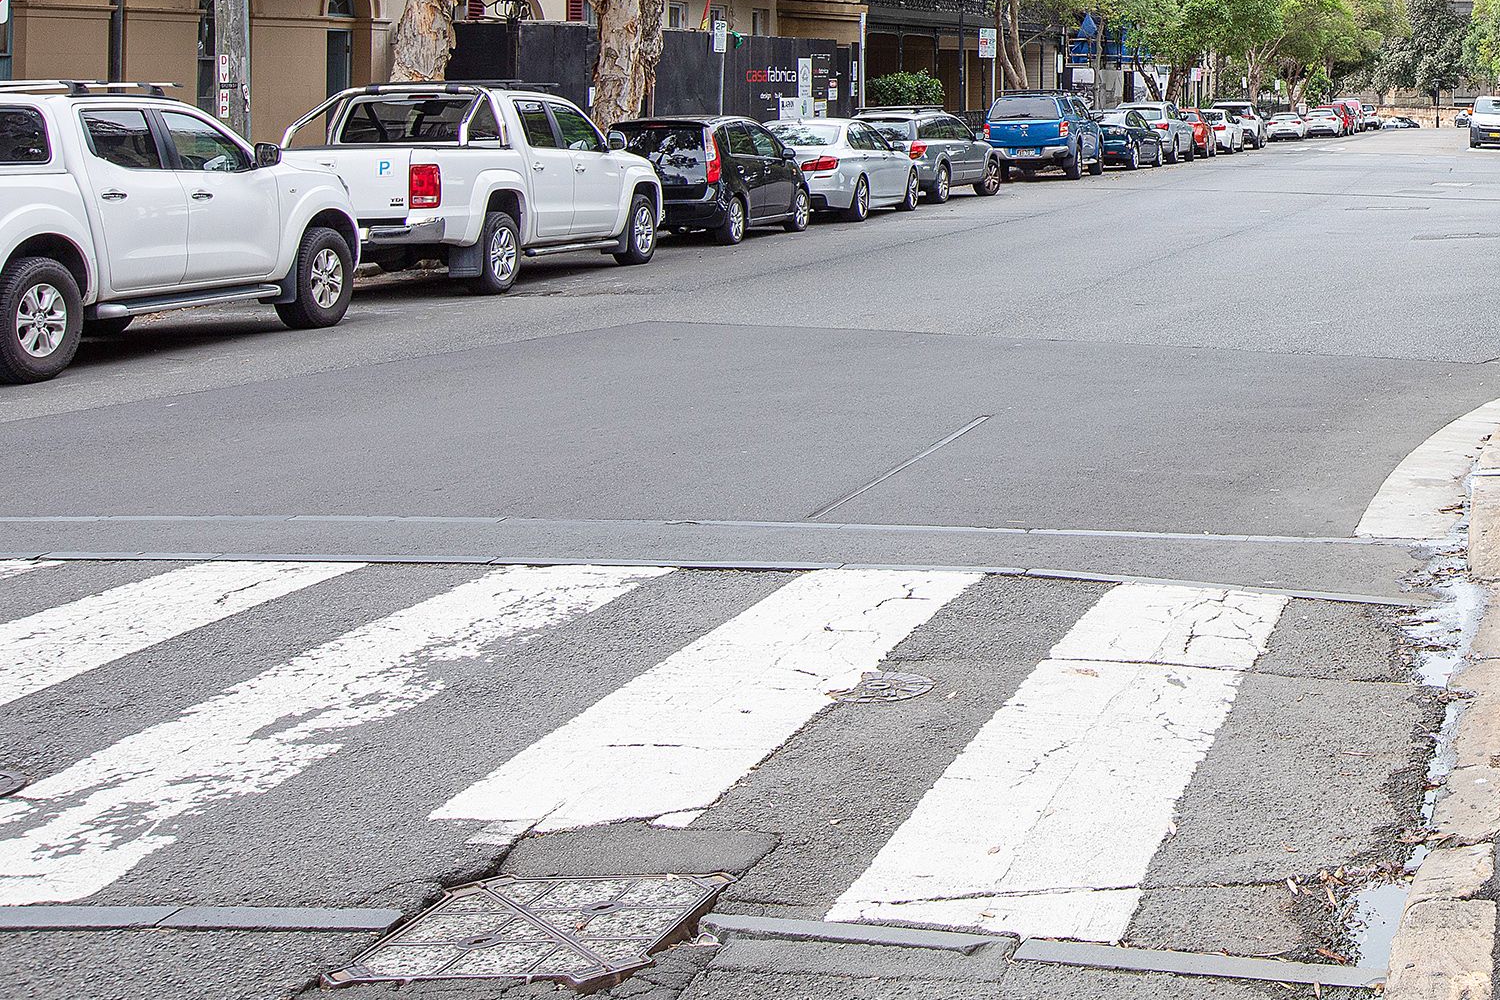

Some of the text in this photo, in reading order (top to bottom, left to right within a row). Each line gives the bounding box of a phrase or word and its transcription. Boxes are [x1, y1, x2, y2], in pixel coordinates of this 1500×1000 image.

[715, 22, 726, 30] 2P
[746, 66, 797, 83] casafabrica
[379, 161, 390, 175] P
